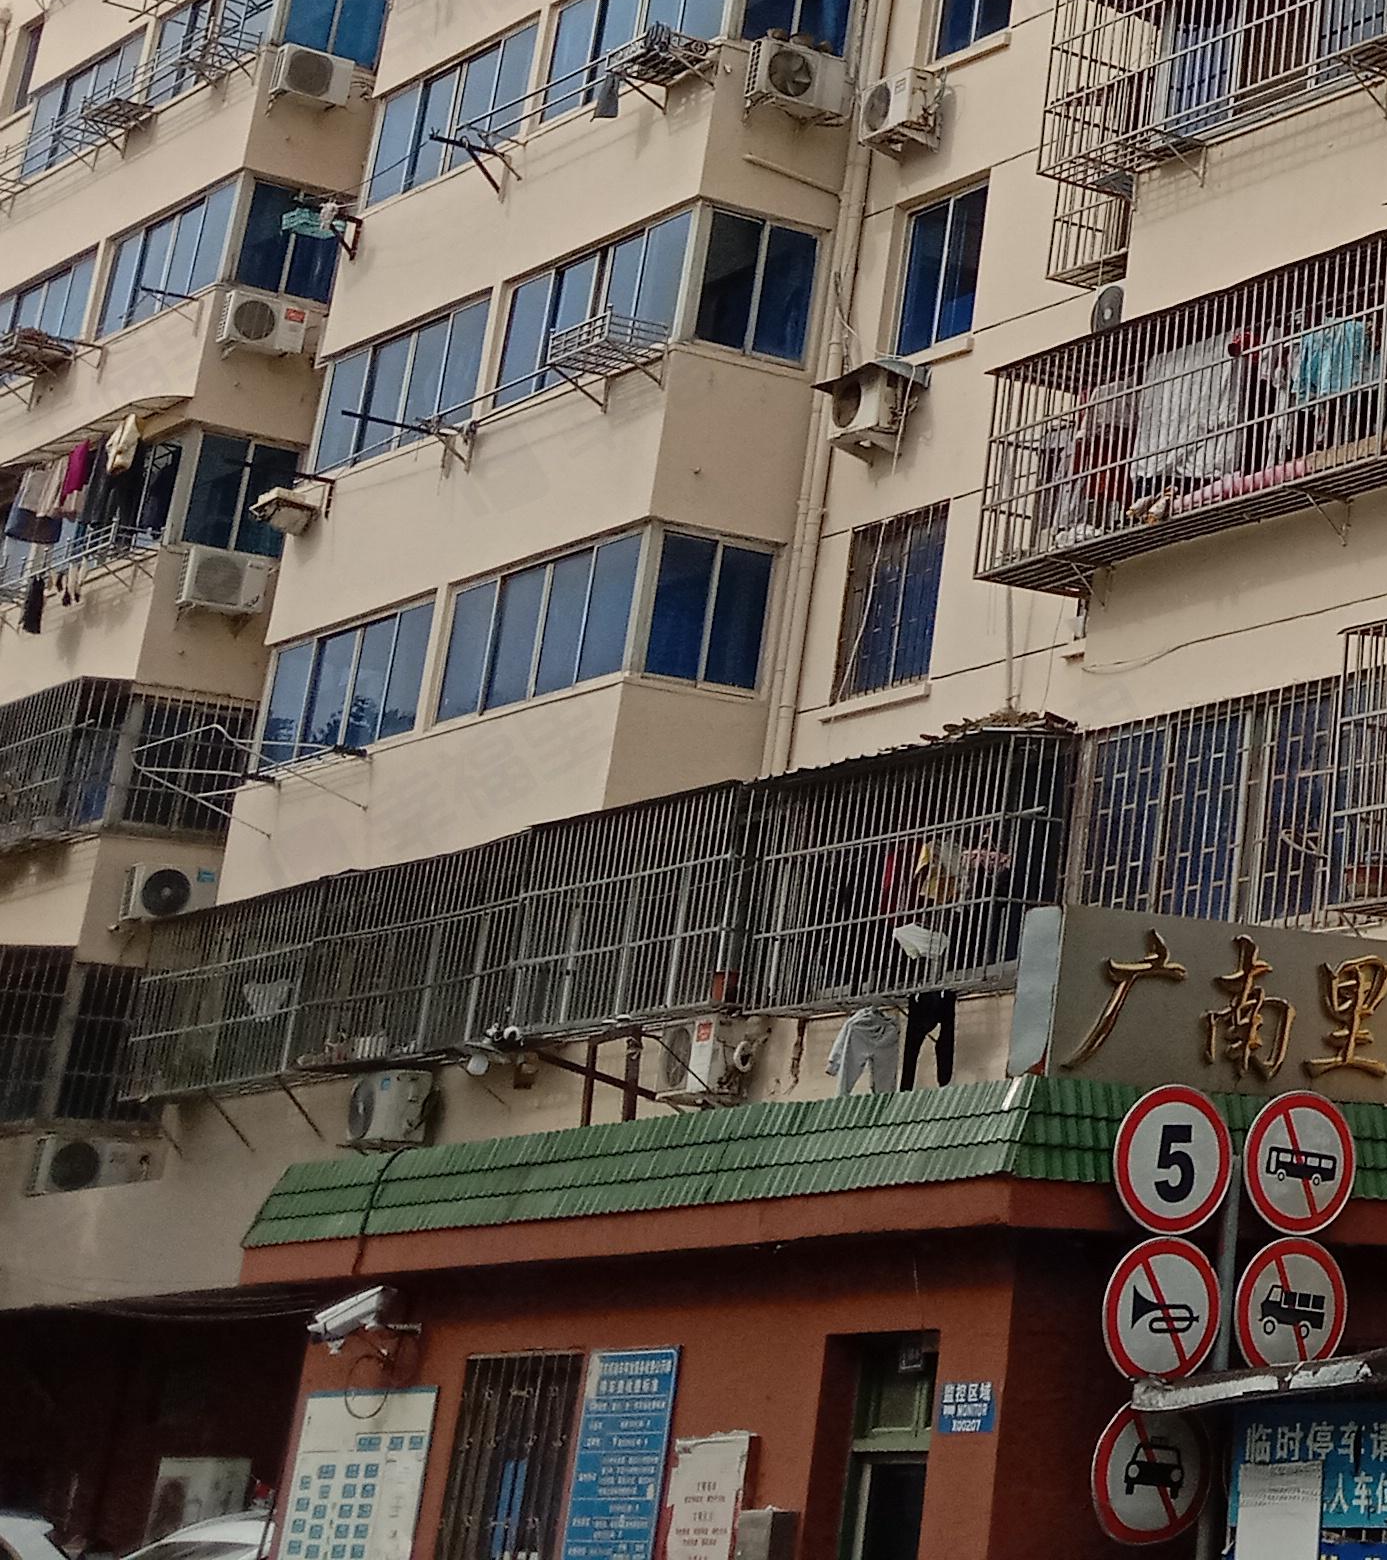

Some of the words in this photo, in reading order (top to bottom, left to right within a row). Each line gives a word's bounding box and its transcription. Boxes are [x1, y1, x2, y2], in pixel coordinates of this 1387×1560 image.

[1154, 1124, 1195, 1203] 5
[942, 1382, 992, 1403] 监控区域
